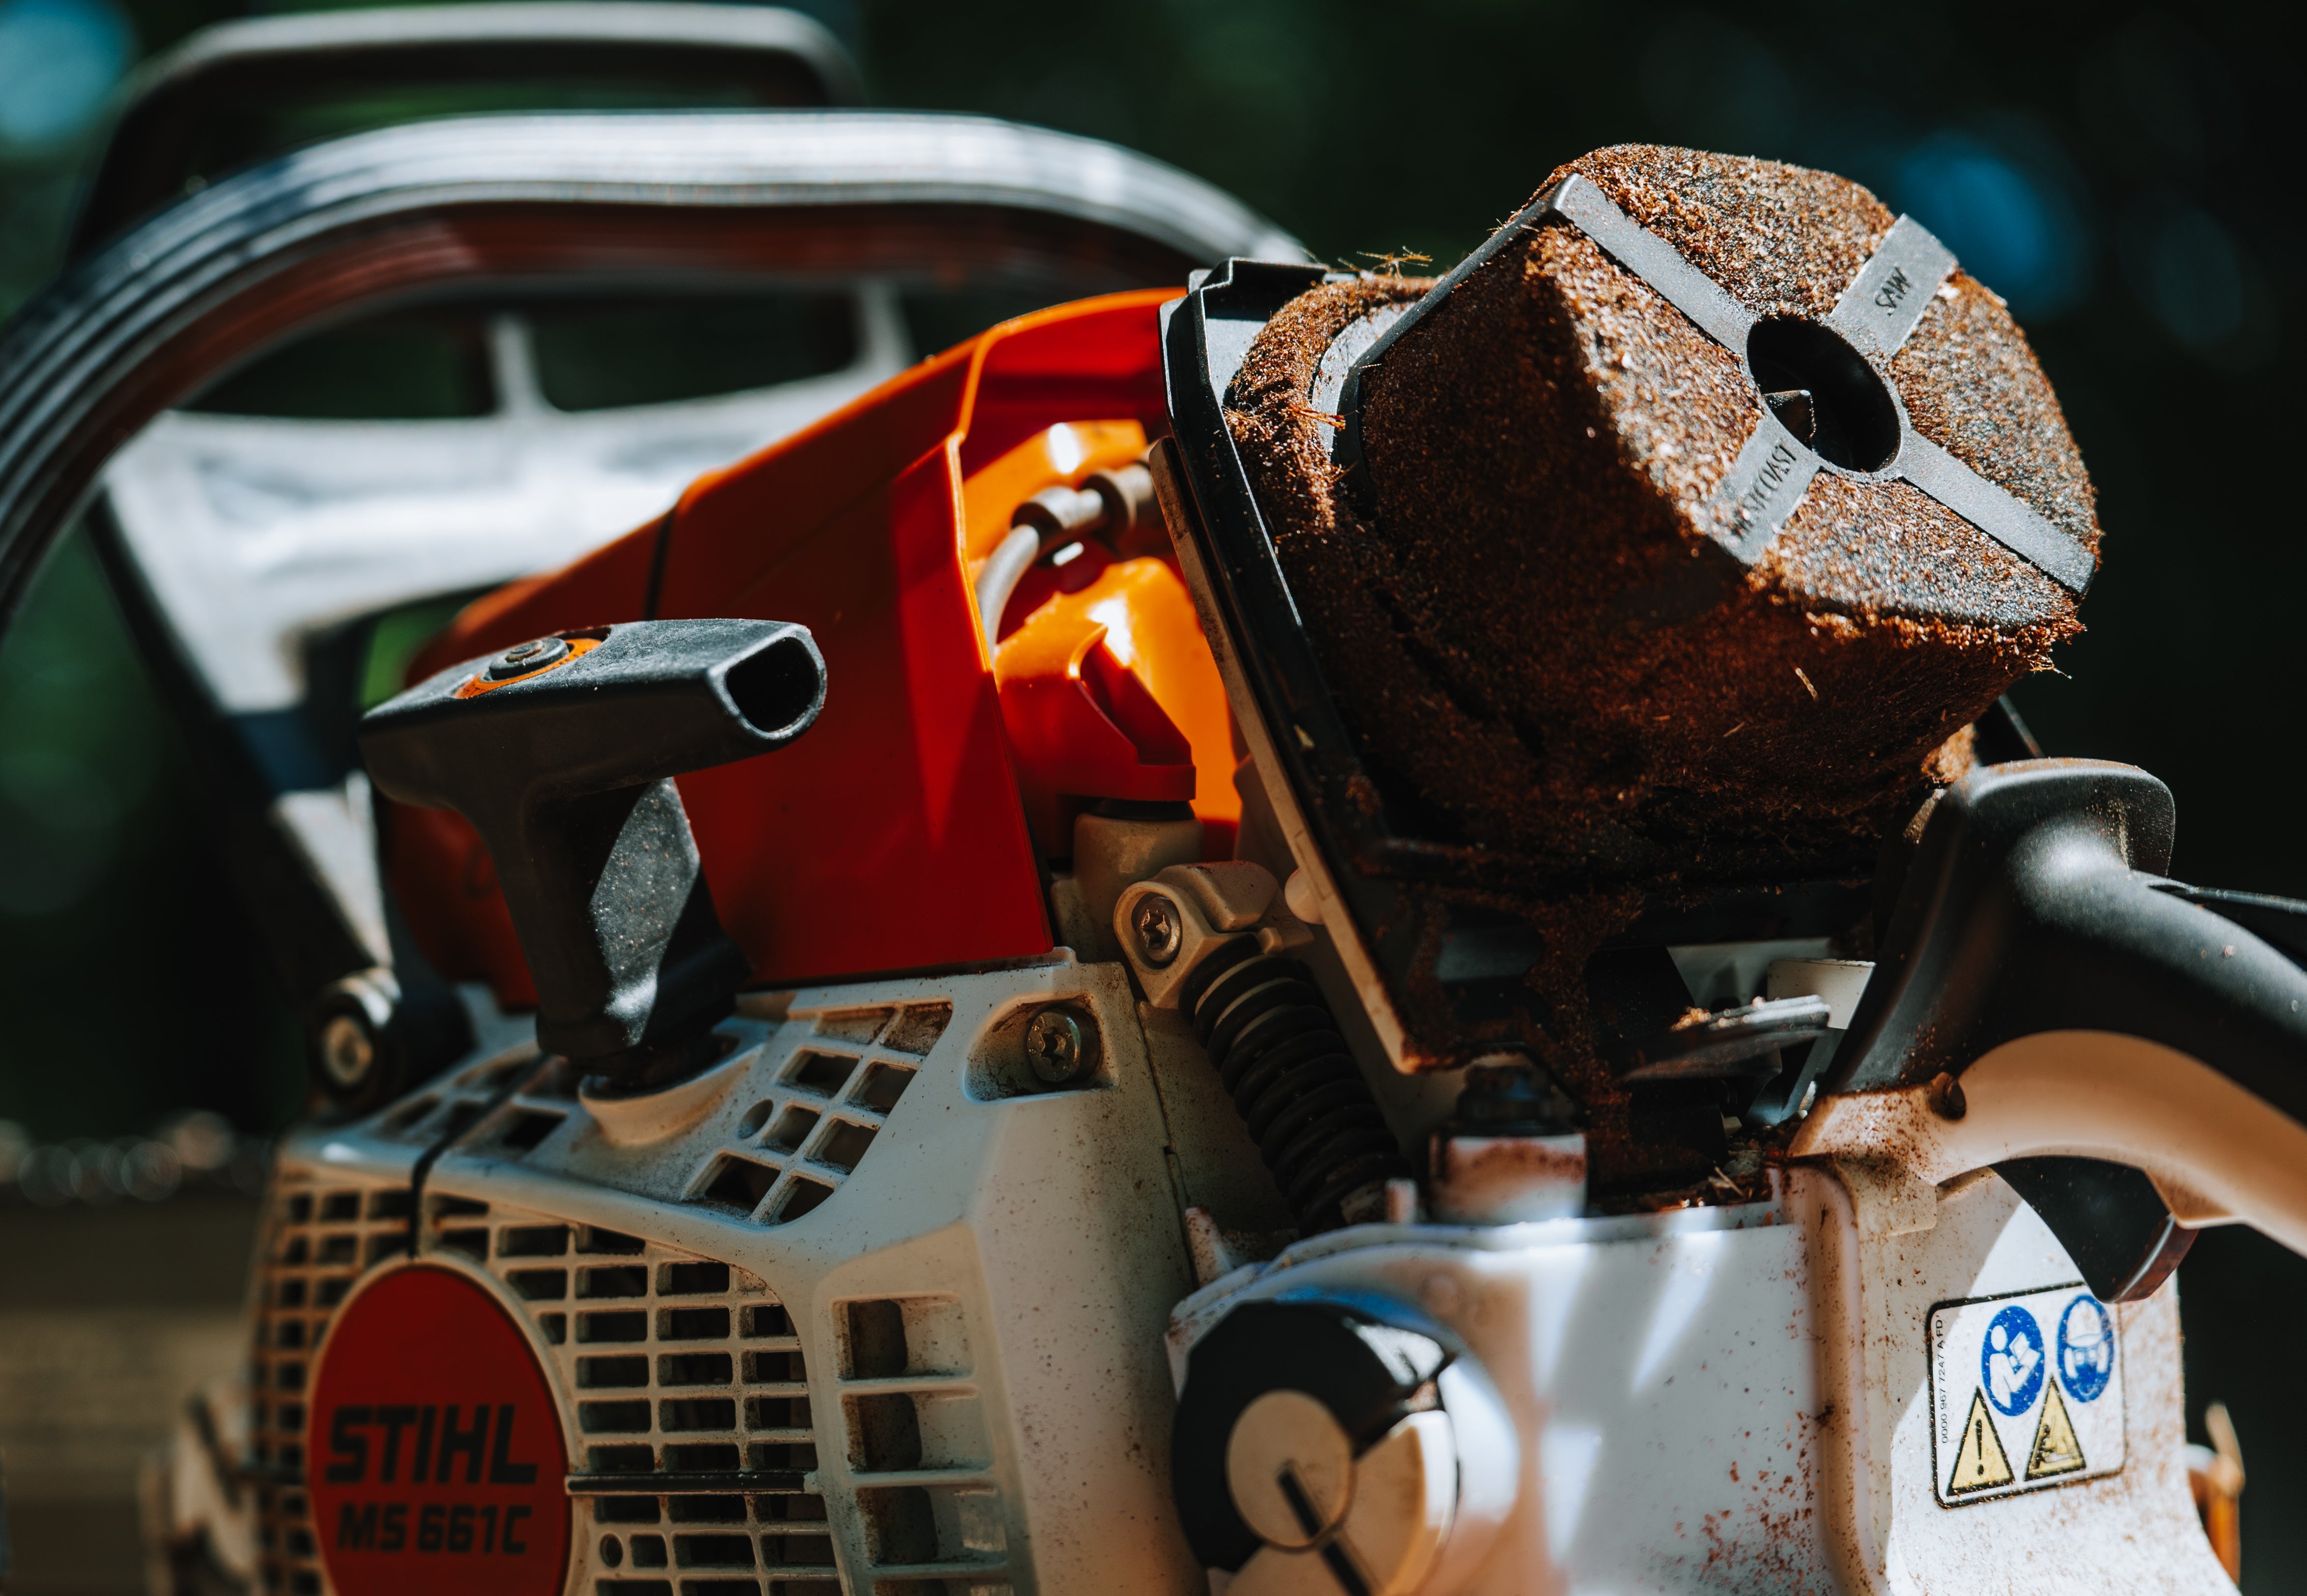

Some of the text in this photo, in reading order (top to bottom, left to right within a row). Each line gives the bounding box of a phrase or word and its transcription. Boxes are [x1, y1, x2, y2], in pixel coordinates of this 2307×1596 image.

[1874, 266, 1911, 316] SAW
[1936, 1319, 1943, 1337] FD
[1937, 1340, 1944, 1349] A
[1937, 1354, 1946, 1382] 7247
[325, 1404, 539, 1484] STIHL
[1940, 1413, 1948, 1444] 0000
[338, 1503, 533, 1554] MS 661C
